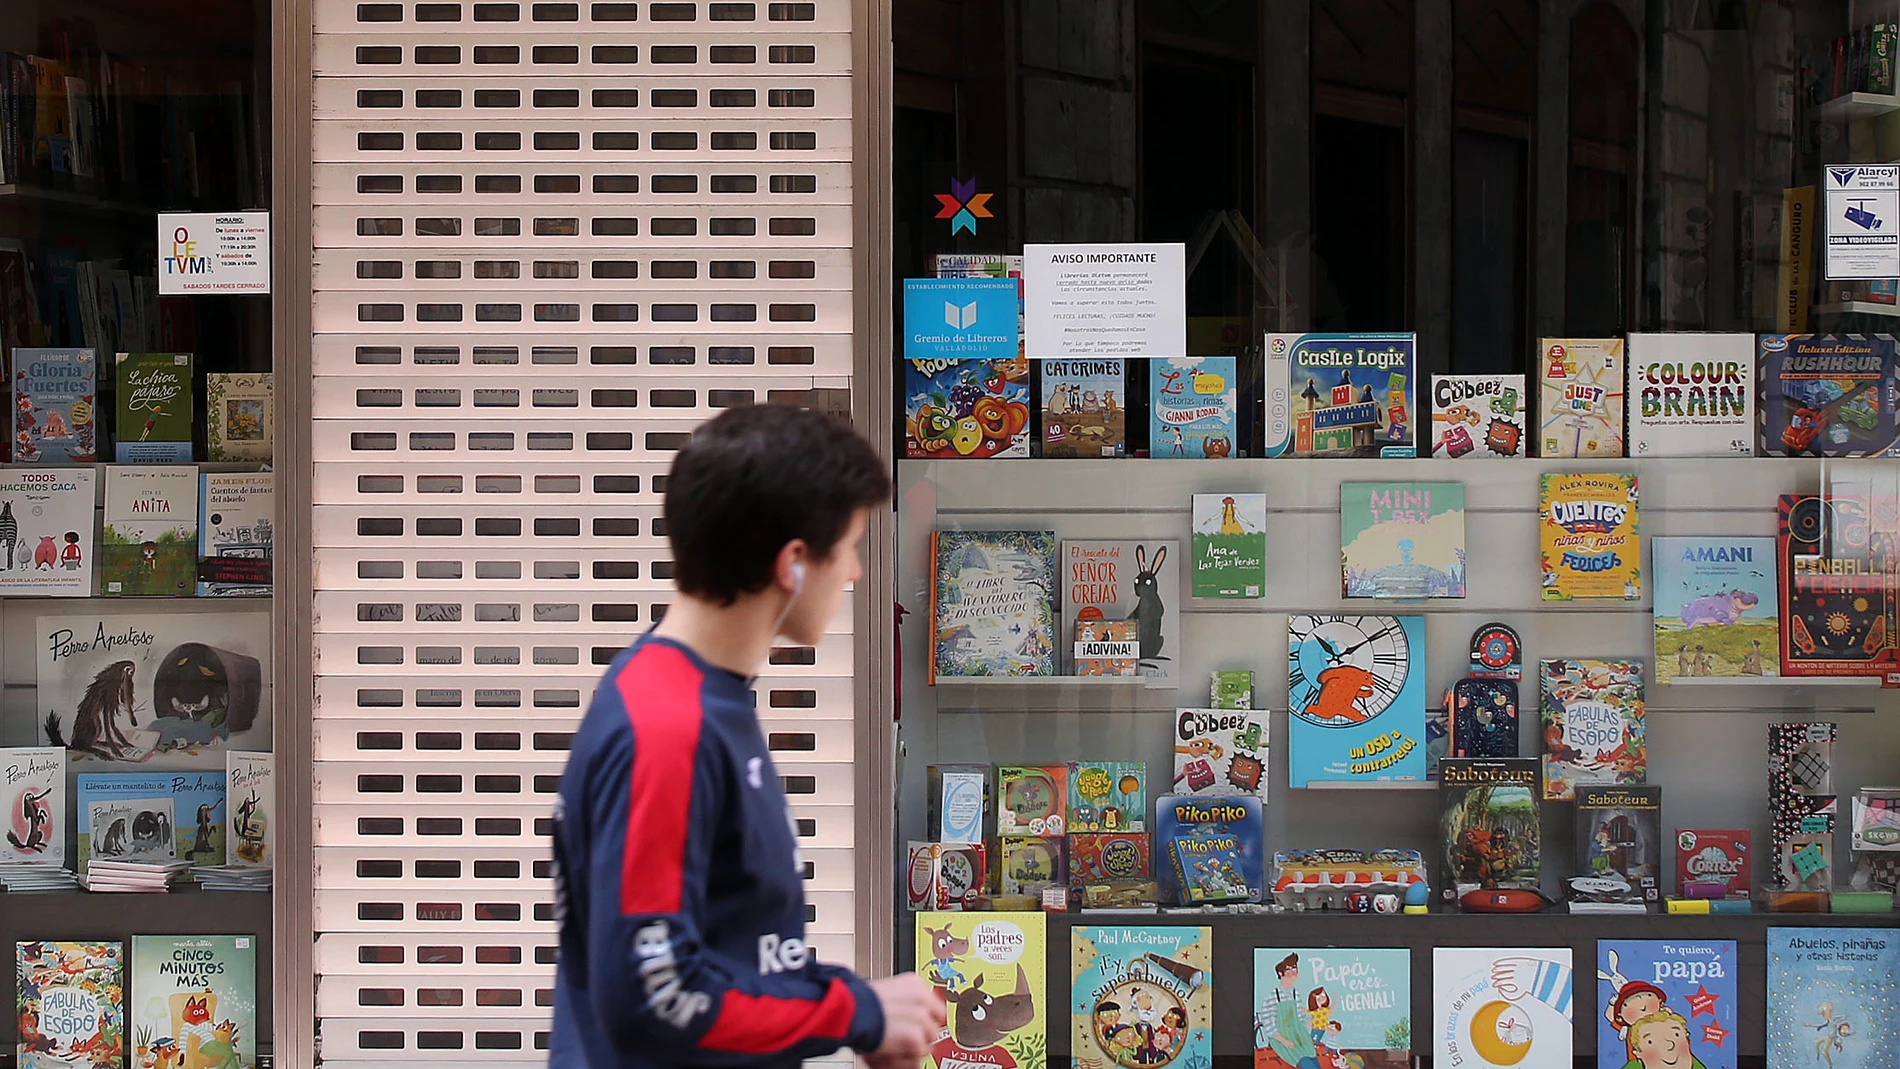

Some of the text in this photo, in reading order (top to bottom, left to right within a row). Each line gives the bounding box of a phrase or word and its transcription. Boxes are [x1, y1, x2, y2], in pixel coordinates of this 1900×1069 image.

[1858, 168, 1897, 177] Alarcyl
[1792, 202, 1802, 257] CANGURO
[164, 257, 205, 274] TVM
[1051, 253, 1156, 263] AVISO IMPORTANTE
[1789, 290, 1798, 315] CLUB
[914, 334, 1008, 343] Gremio de Libreros
[1797, 345, 1872, 353] Deluxe Edition
[1298, 348, 1405, 369] Castle Logix
[1782, 356, 1883, 371] RUSHHOUR
[29, 362, 82, 378] Gloria
[1046, 360, 1120, 376] CAT CRIMES
[1646, 362, 1740, 384] COLOUR
[143, 369, 178, 385] chica
[1160, 371, 1184, 394] Las
[24, 378, 87, 393] Fuertes
[1435, 379, 1500, 408] Cubeez
[1565, 384, 1603, 403] JUST
[1164, 397, 1223, 405] historias rimas
[1572, 399, 1593, 411] ONE
[1641, 386, 1744, 417] BRAIN
[1166, 407, 1219, 422] GIANNI RODARI
[0, 483, 48, 491] HACEMOS
[1559, 480, 1620, 492] ÁLEX ROVIRA
[1370, 490, 1431, 508] MINI
[1392, 510, 1430, 524] REX
[1554, 535, 1626, 546] niñas niños
[1072, 546, 1120, 558] El del
[1206, 542, 1226, 557] Ana
[1682, 547, 1752, 562] AMANI
[1198, 556, 1260, 570] Las Tejas Verdes
[1560, 550, 1622, 572] FELICES
[1072, 559, 1117, 582] SEÑOR
[976, 577, 1006, 589] LIBRO
[963, 592, 1025, 607] AVENTURERO
[1072, 584, 1117, 604] OREJAS
[955, 602, 1028, 619] DESCONOCIDO
[50, 622, 155, 661] Perro Apestoso
[1082, 643, 1131, 656] ¡ADIVINA!
[1145, 670, 1169, 678] Clark
[1568, 706, 1619, 726] FÁBULAS
[1178, 712, 1245, 740] Cubeez
[1586, 722, 1599, 731] DE
[1350, 730, 1401, 758] UN OSO a
[1569, 728, 1619, 746] ESOPO
[5, 765, 26, 785] Perro
[231, 768, 246, 788] Perro
[1079, 770, 1111, 786] Jungle
[1444, 766, 1535, 780] Saboteur
[85, 782, 110, 791] Llévate
[172, 777, 193, 794] Perro
[1588, 794, 1648, 805] Saboteur
[1176, 806, 1246, 822] Piko Piko
[1106, 847, 1132, 860] Jungle
[1179, 839, 1233, 853] Piko Piko
[981, 924, 995, 933] Los
[978, 930, 1023, 948] padres
[1098, 929, 1181, 951] Paul McCartney
[1842, 938, 1886, 951] pirañas
[1663, 945, 1715, 956] Te quiero,
[1796, 952, 1878, 961] y otras historias
[1652, 955, 1725, 984] papá
[177, 974, 209, 987] MÁS
[1092, 963, 1196, 1002] superabuelo!
[44, 991, 95, 1013] FÁBULAS
[1341, 990, 1395, 1011] ¡GENIAL!
[61, 1008, 74, 1018] DE
[44, 1015, 96, 1035] ESOPO
[1447, 977, 1489, 1067] En los brazos de mi papá
